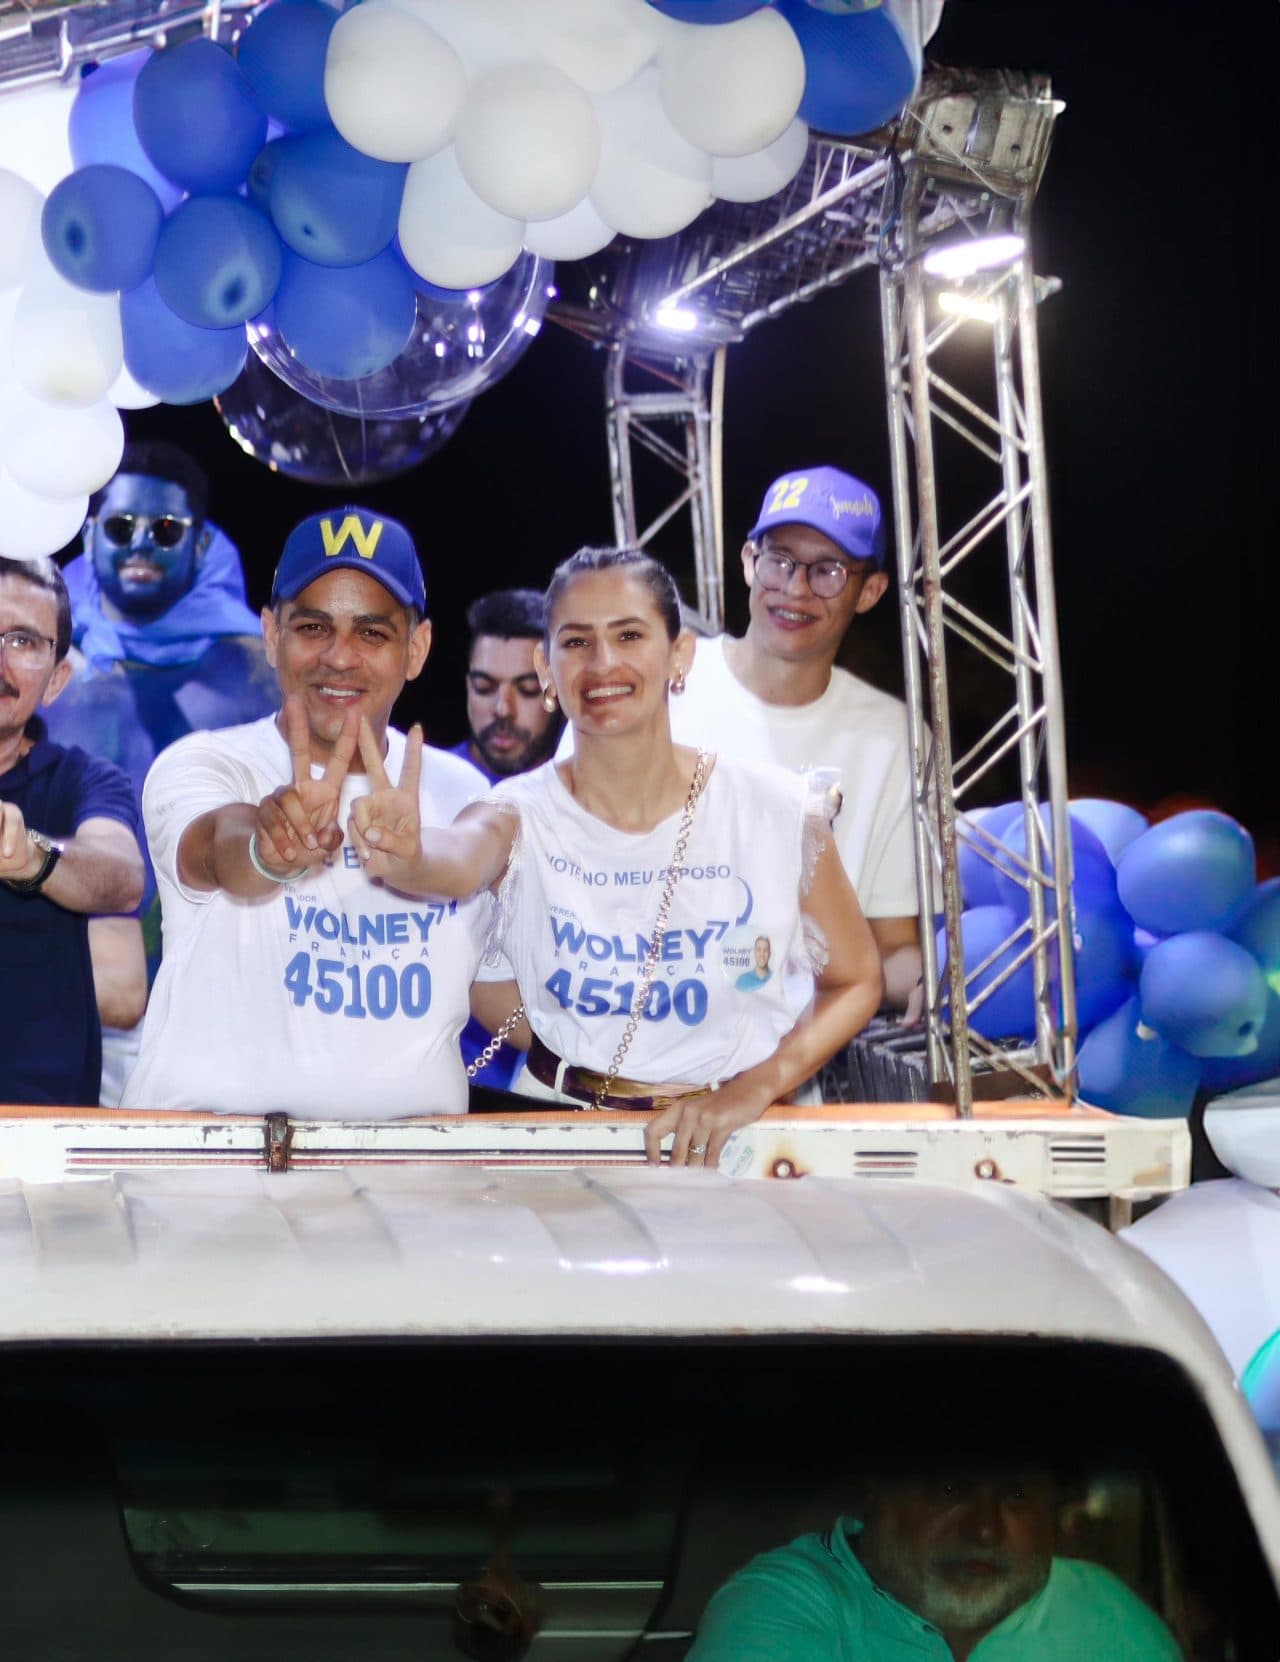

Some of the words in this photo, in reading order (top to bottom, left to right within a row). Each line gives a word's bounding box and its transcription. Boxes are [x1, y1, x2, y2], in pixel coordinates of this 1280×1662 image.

[768, 478, 808, 513] 22
[320, 514, 383, 559] W
[582, 870, 608, 887] NO
[614, 870, 653, 886] MEU
[656, 864, 731, 883] EPOSO
[550, 915, 715, 963] WOLNEY
[722, 957, 751, 968] 45100
[284, 951, 432, 1020] 45100
[545, 967, 709, 1027] 45100
